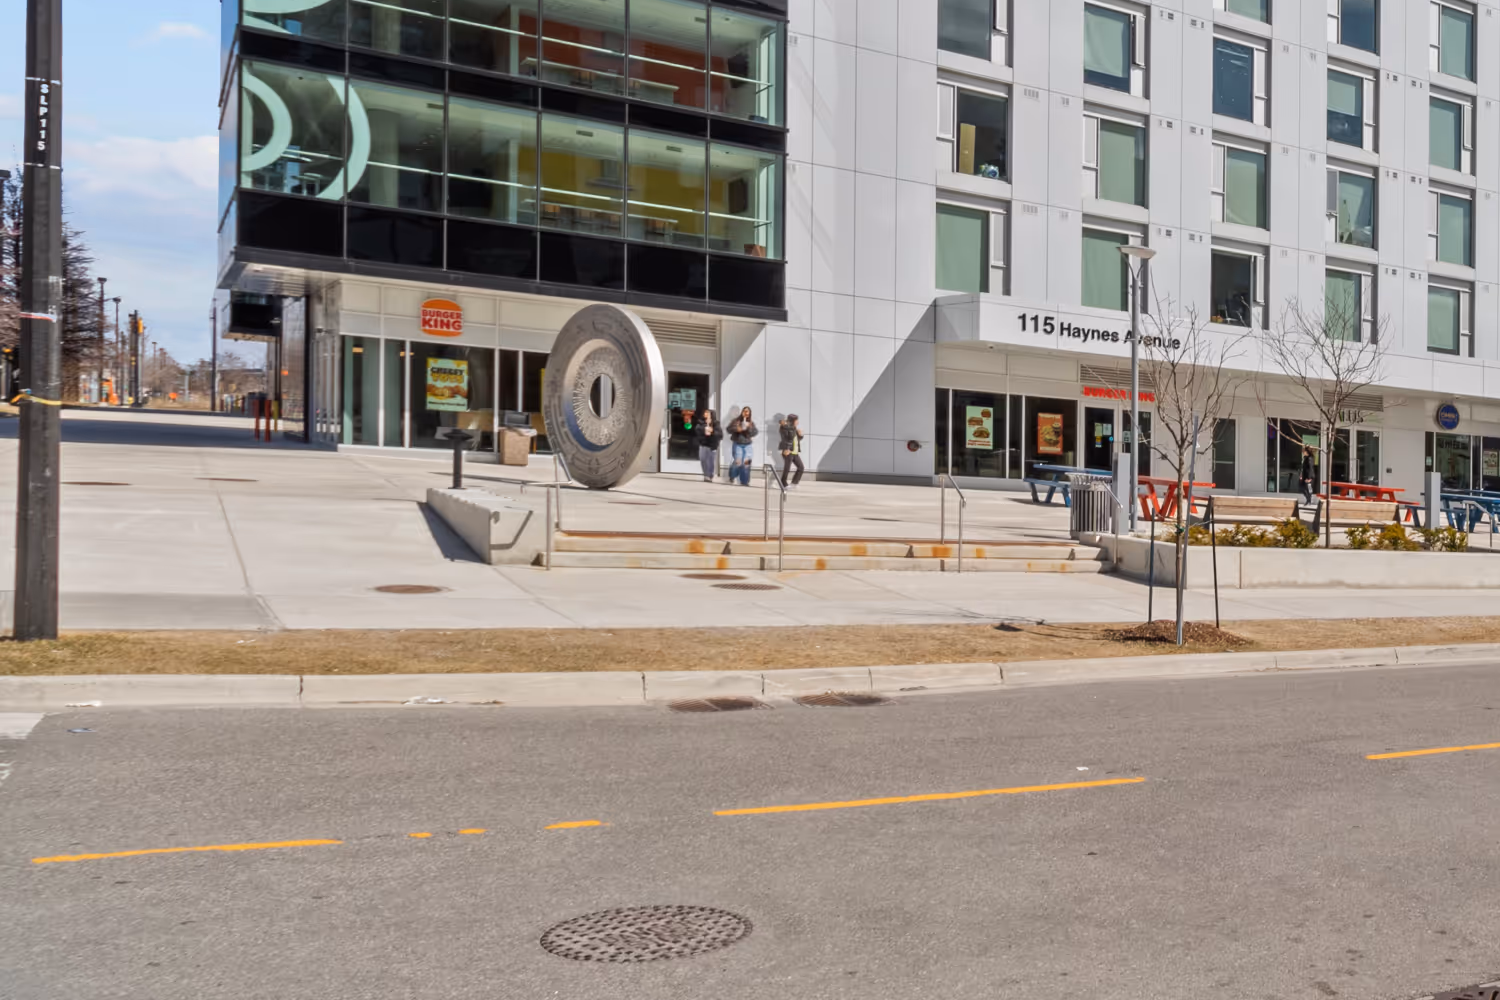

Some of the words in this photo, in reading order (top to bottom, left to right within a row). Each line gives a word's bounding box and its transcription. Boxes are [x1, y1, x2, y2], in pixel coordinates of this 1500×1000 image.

[422, 309, 463, 320] BURGER
[422, 317, 463, 331] KING
[1018, 313, 1055, 335] 115
[1060, 321, 1120, 343] Haynes
[1083, 386, 1126, 400] BURGER
